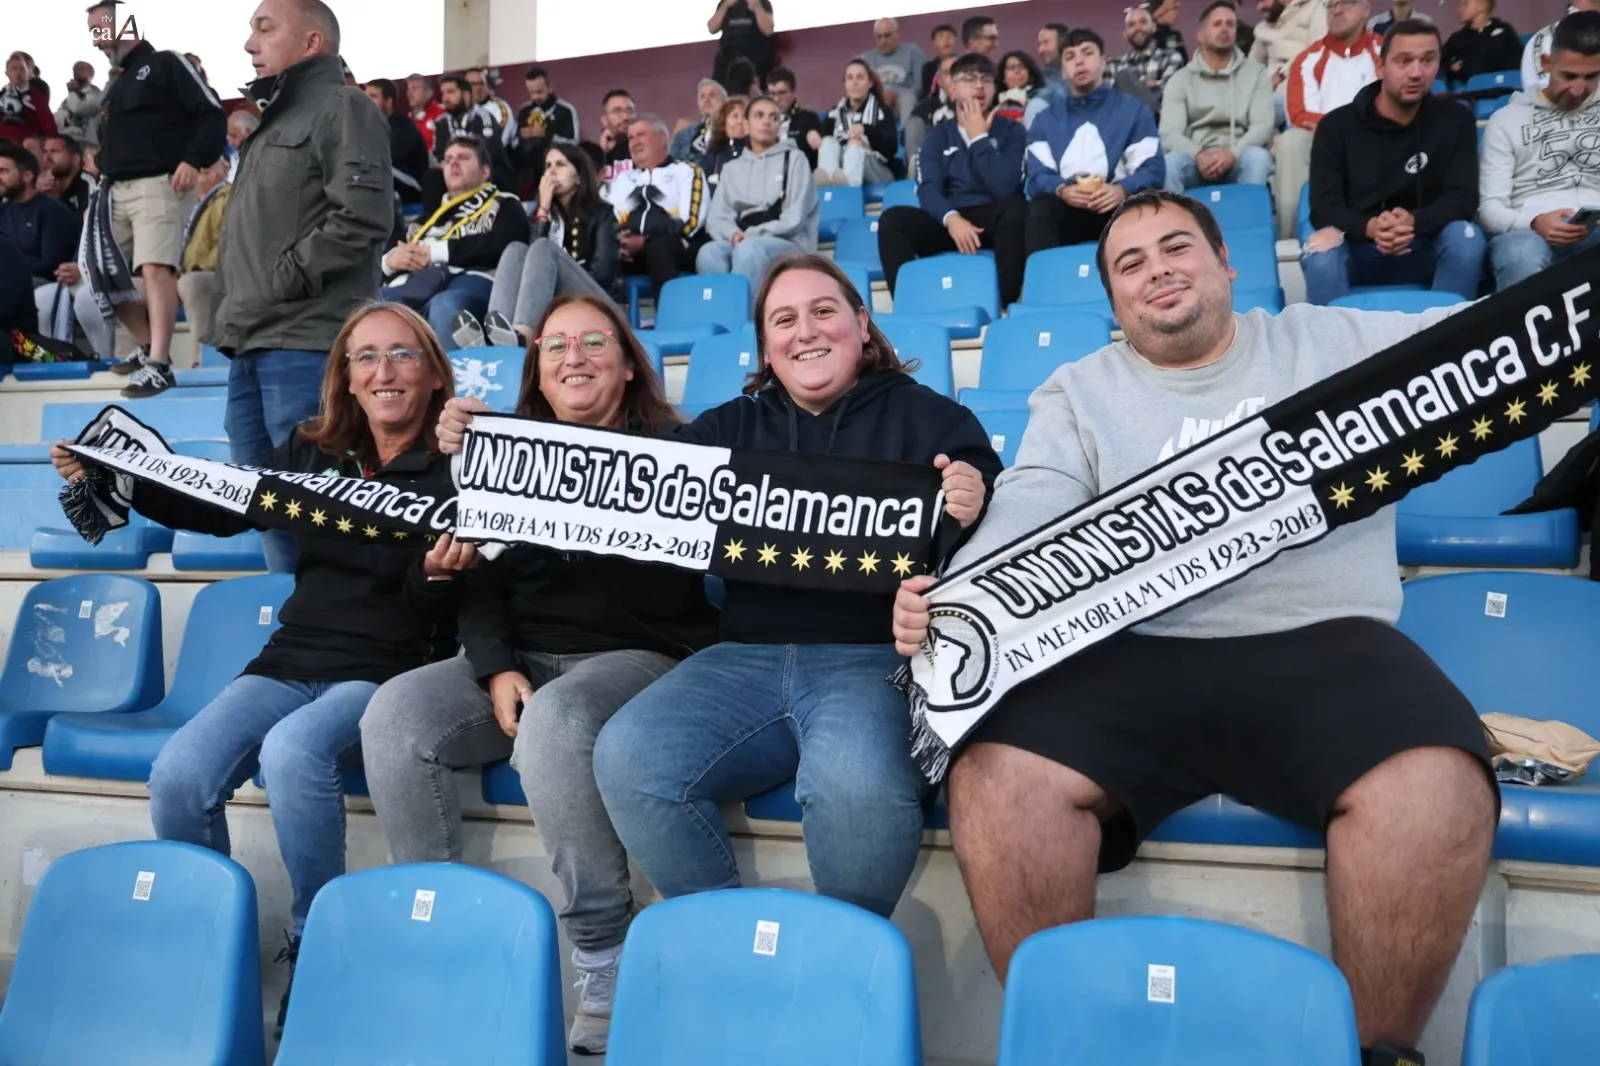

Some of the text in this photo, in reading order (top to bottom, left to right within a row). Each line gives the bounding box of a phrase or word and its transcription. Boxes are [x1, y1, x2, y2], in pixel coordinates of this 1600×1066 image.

[139, 452, 172, 476] VDS
[971, 472, 1229, 619] UNIONISTAS
[1215, 457, 1285, 512] de
[1261, 335, 1527, 486] Salamanca
[459, 430, 658, 514] UNIONISTAS
[655, 464, 704, 520] de
[704, 468, 923, 538] Salamanca
[563, 522, 603, 544] VDS
[1165, 557, 1208, 596] VDS
